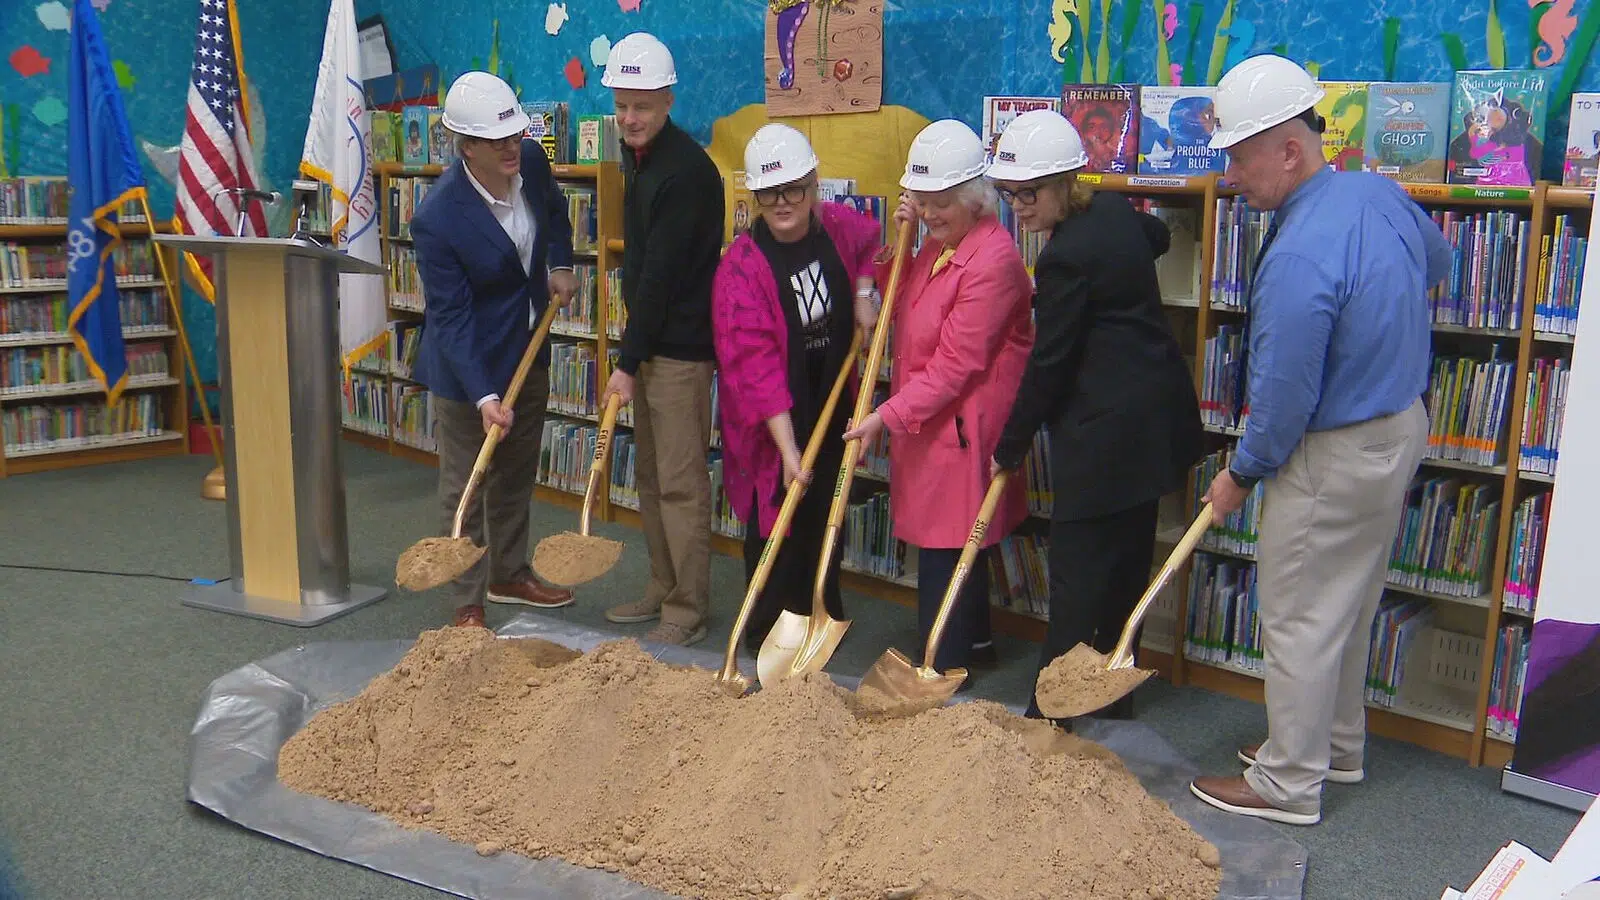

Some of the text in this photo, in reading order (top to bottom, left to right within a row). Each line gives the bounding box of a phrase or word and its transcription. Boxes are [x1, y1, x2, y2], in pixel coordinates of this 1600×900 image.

[1070, 90, 1131, 101] REMEMBER
[1381, 132, 1427, 146] GHOST
[1177, 145, 1221, 157] PROUDEST
[1188, 157, 1211, 169] BLUE
[1133, 178, 1181, 187] Transportation
[1474, 189, 1505, 198] Nature
